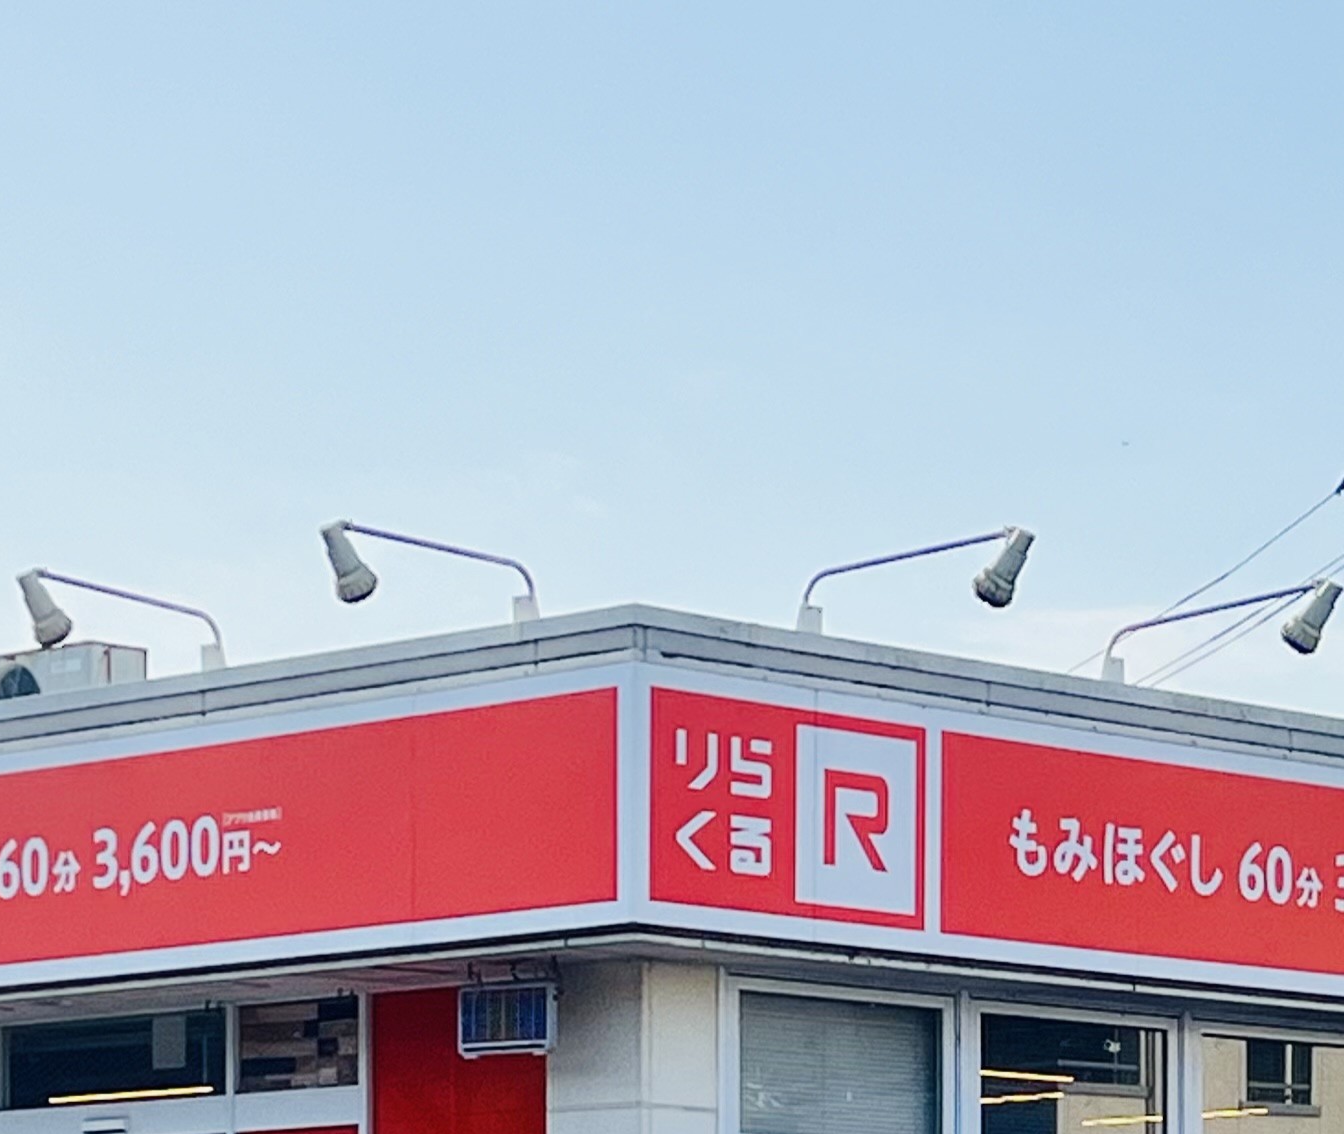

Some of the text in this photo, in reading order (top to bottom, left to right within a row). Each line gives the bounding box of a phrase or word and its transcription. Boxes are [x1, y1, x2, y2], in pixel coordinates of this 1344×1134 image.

[675, 728, 773, 800] りら
[675, 810, 773, 877] くる
[824, 768, 889, 873] R
[1009, 808, 1224, 896] もみほぐし
[1239, 842, 1323, 908] 60分
